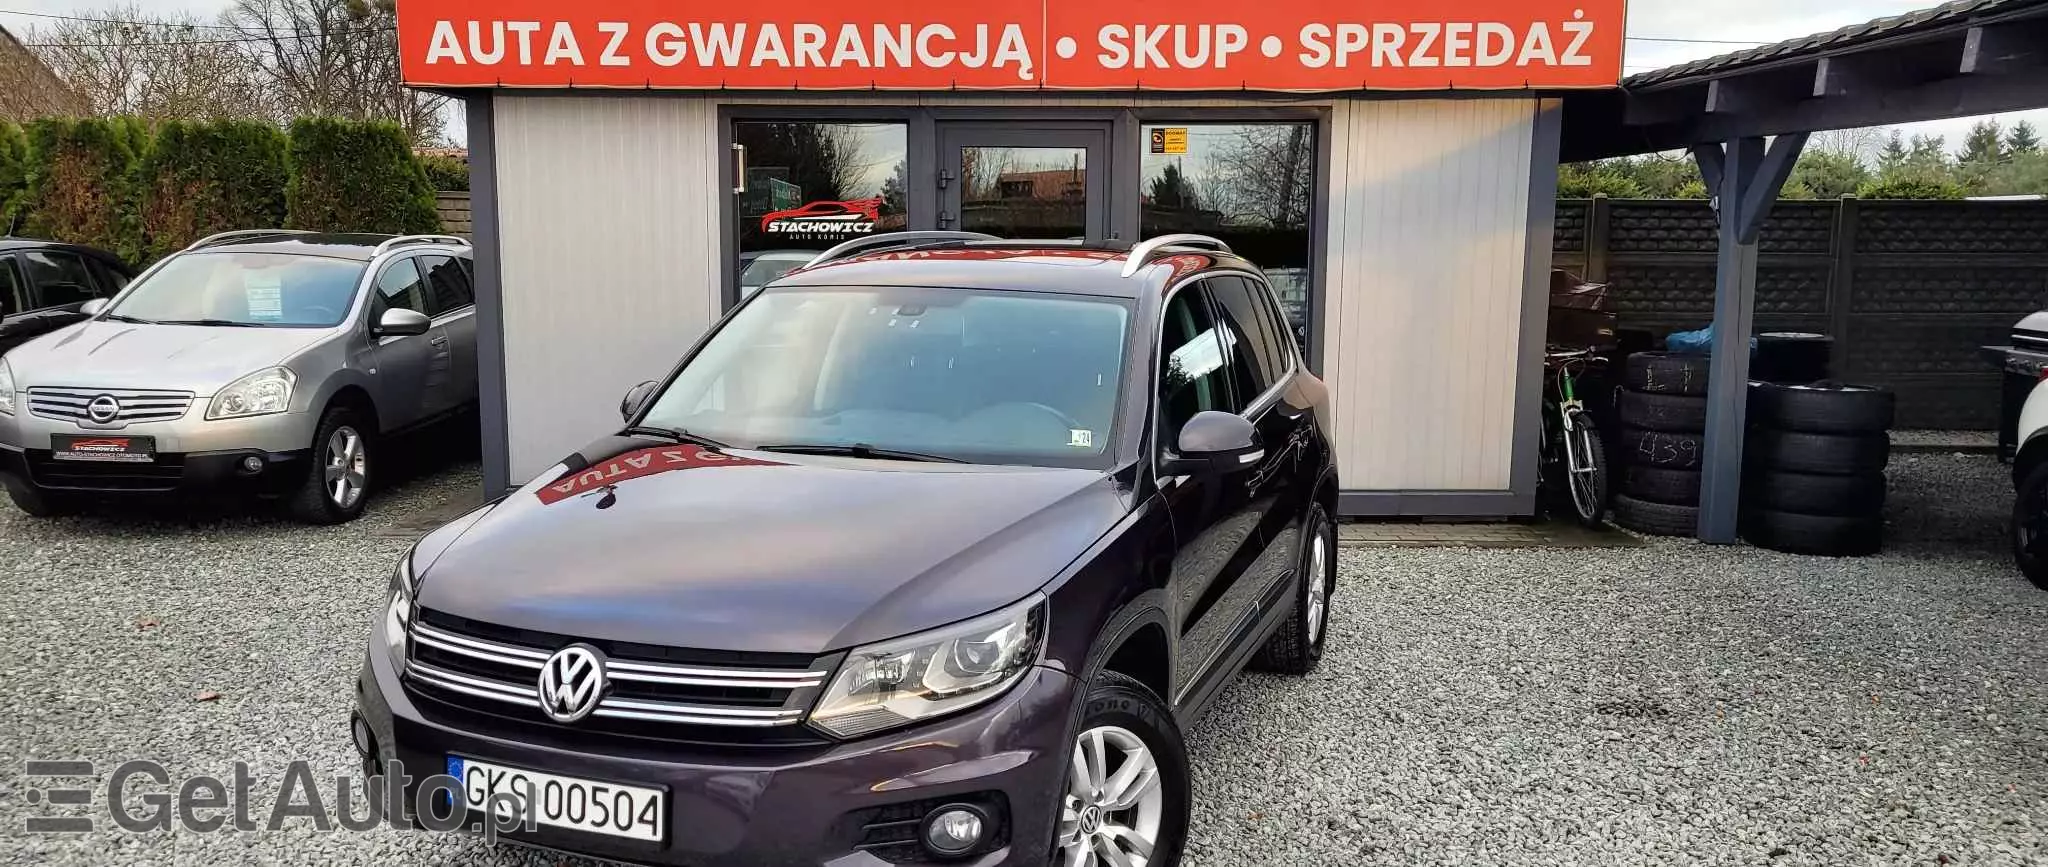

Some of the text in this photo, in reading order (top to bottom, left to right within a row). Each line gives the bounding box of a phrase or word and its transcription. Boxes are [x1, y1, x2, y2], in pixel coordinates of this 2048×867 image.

[426, 8, 1593, 80] AUTA Z GWARANCJĄ SKUP SPRZEDAŻ
[768, 222, 874, 232] STACHOWICZ
[1639, 431, 1697, 467] 439
[544, 779, 658, 837] 00504
